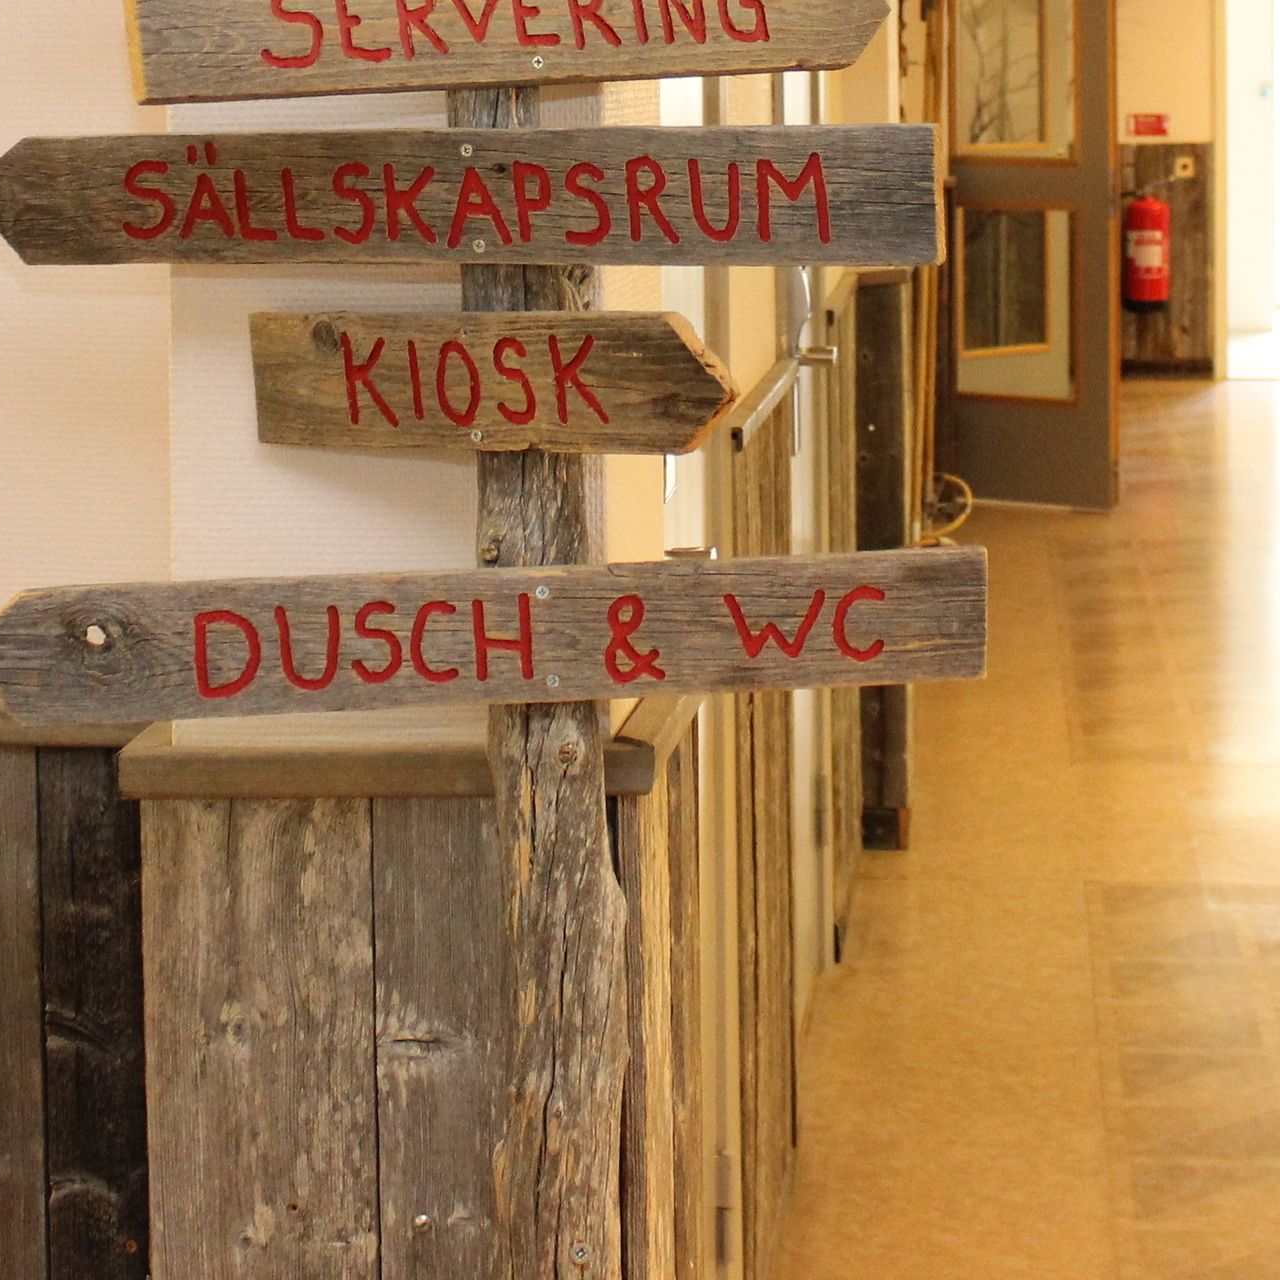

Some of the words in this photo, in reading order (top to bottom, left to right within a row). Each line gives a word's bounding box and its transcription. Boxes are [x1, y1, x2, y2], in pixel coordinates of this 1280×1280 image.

[122, 142, 831, 250] SÄLLSKAPSRUM
[340, 334, 611, 429] KIOSK
[192, 592, 535, 701] DUSCH
[602, 593, 667, 688] &
[722, 583, 887, 664] WC
